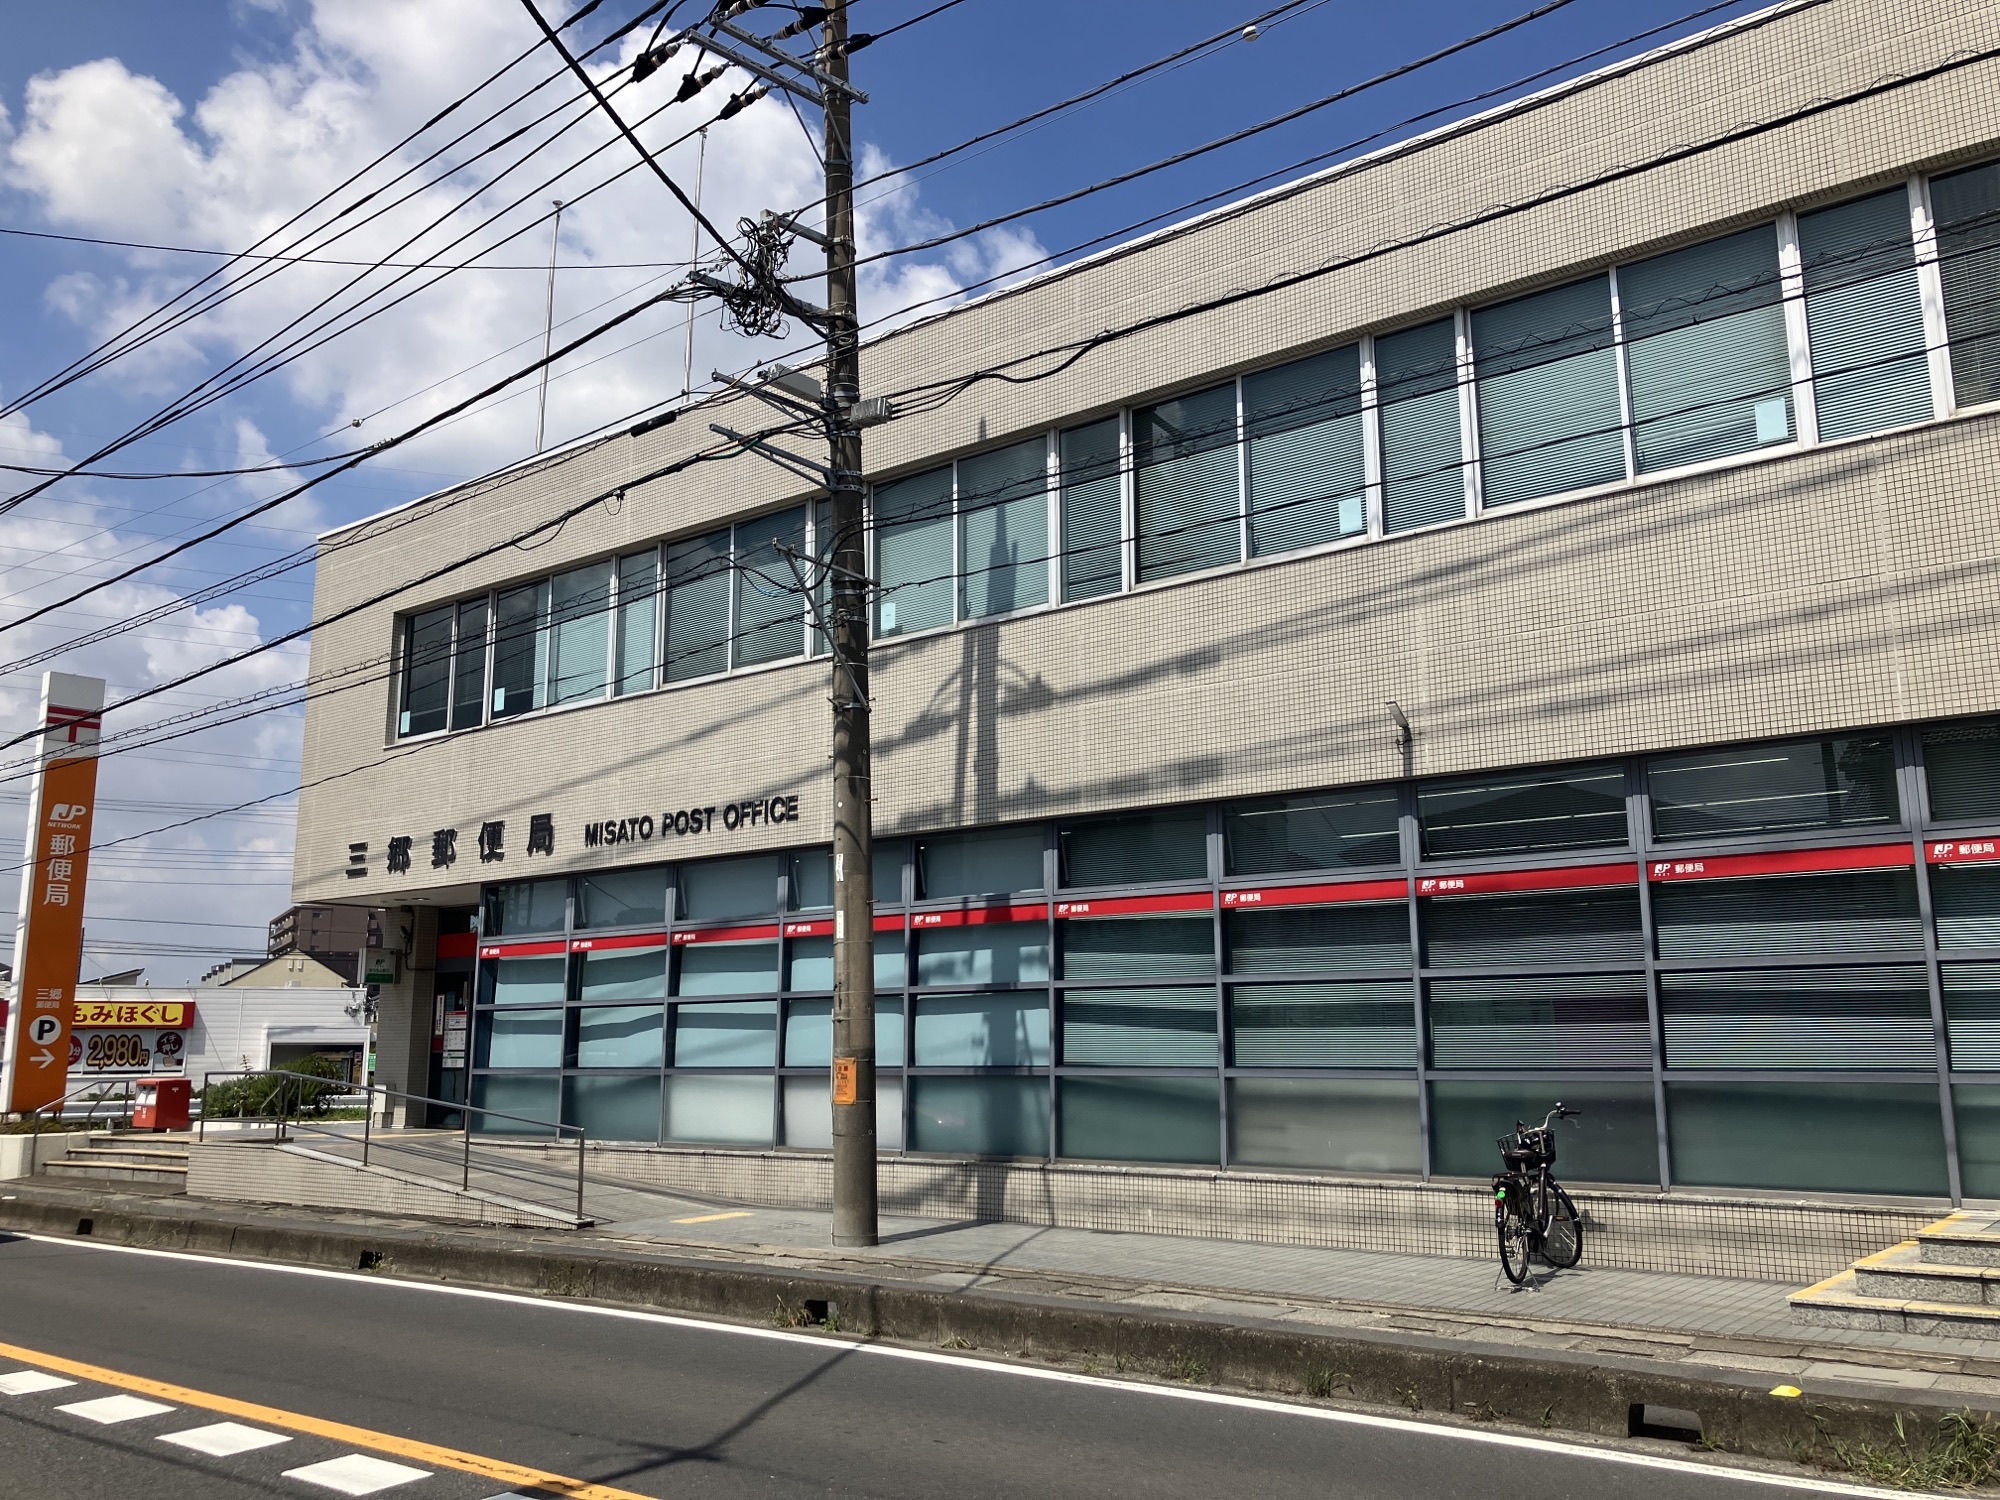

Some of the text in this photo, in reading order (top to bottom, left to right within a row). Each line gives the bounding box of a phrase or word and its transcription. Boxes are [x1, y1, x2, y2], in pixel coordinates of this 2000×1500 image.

[47, 822, 81, 830] NETWORK
[585, 796, 798, 847] MISATO POST OFFICE
[346, 813, 554, 879] 三郷郵便局
[1958, 843, 1994, 854] 郵便局
[43, 834, 76, 907] 郵便局
[1675, 863, 1704, 873] 郵便局
[35, 988, 62, 1000] 三郷
[73, 1004, 179, 1023] もみほぐし
[37, 1019, 56, 1041] P
